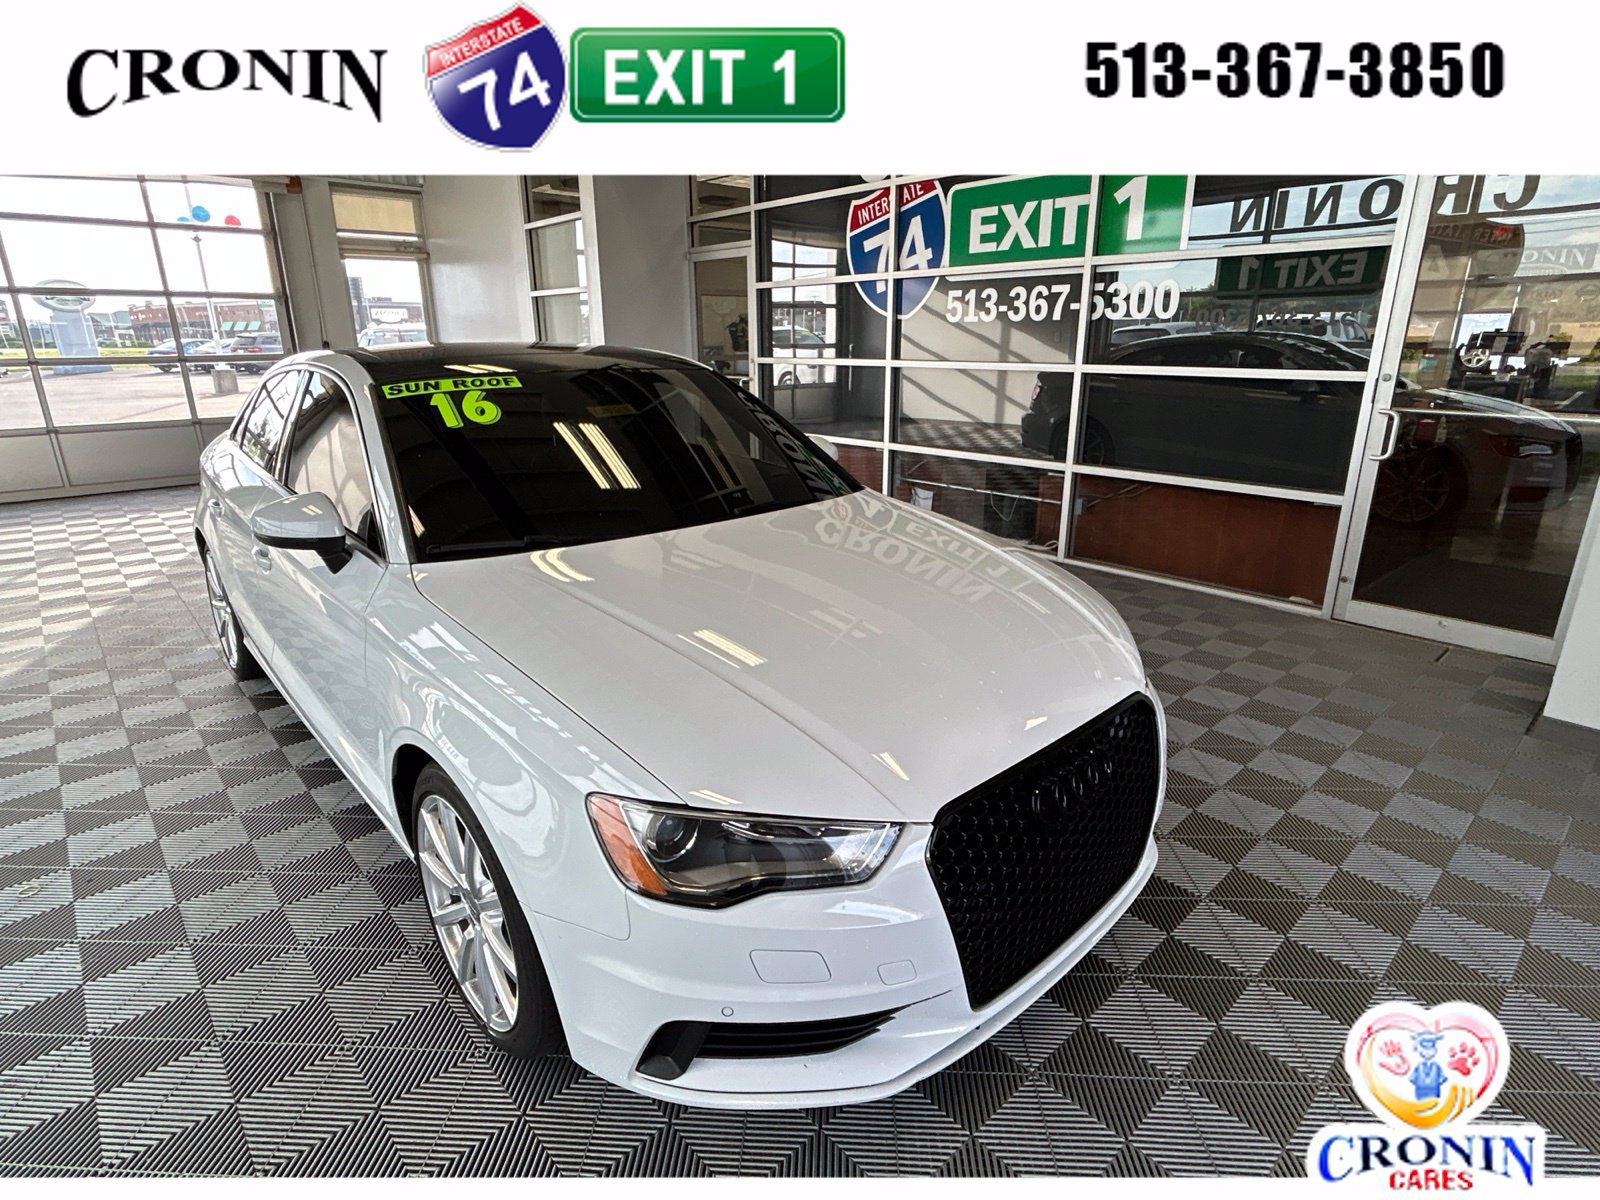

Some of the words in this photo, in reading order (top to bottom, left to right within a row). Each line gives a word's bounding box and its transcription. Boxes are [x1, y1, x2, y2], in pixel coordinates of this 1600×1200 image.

[858, 184, 925, 225] INTERATE
[968, 194, 1091, 254] EXIT
[1113, 175, 1149, 242] 1
[863, 215, 933, 294] 74
[945, 279, 1181, 323] 513-367-5300
[387, 381, 441, 397] SUN
[453, 376, 516, 390] ROOF
[430, 390, 502, 428] 16
